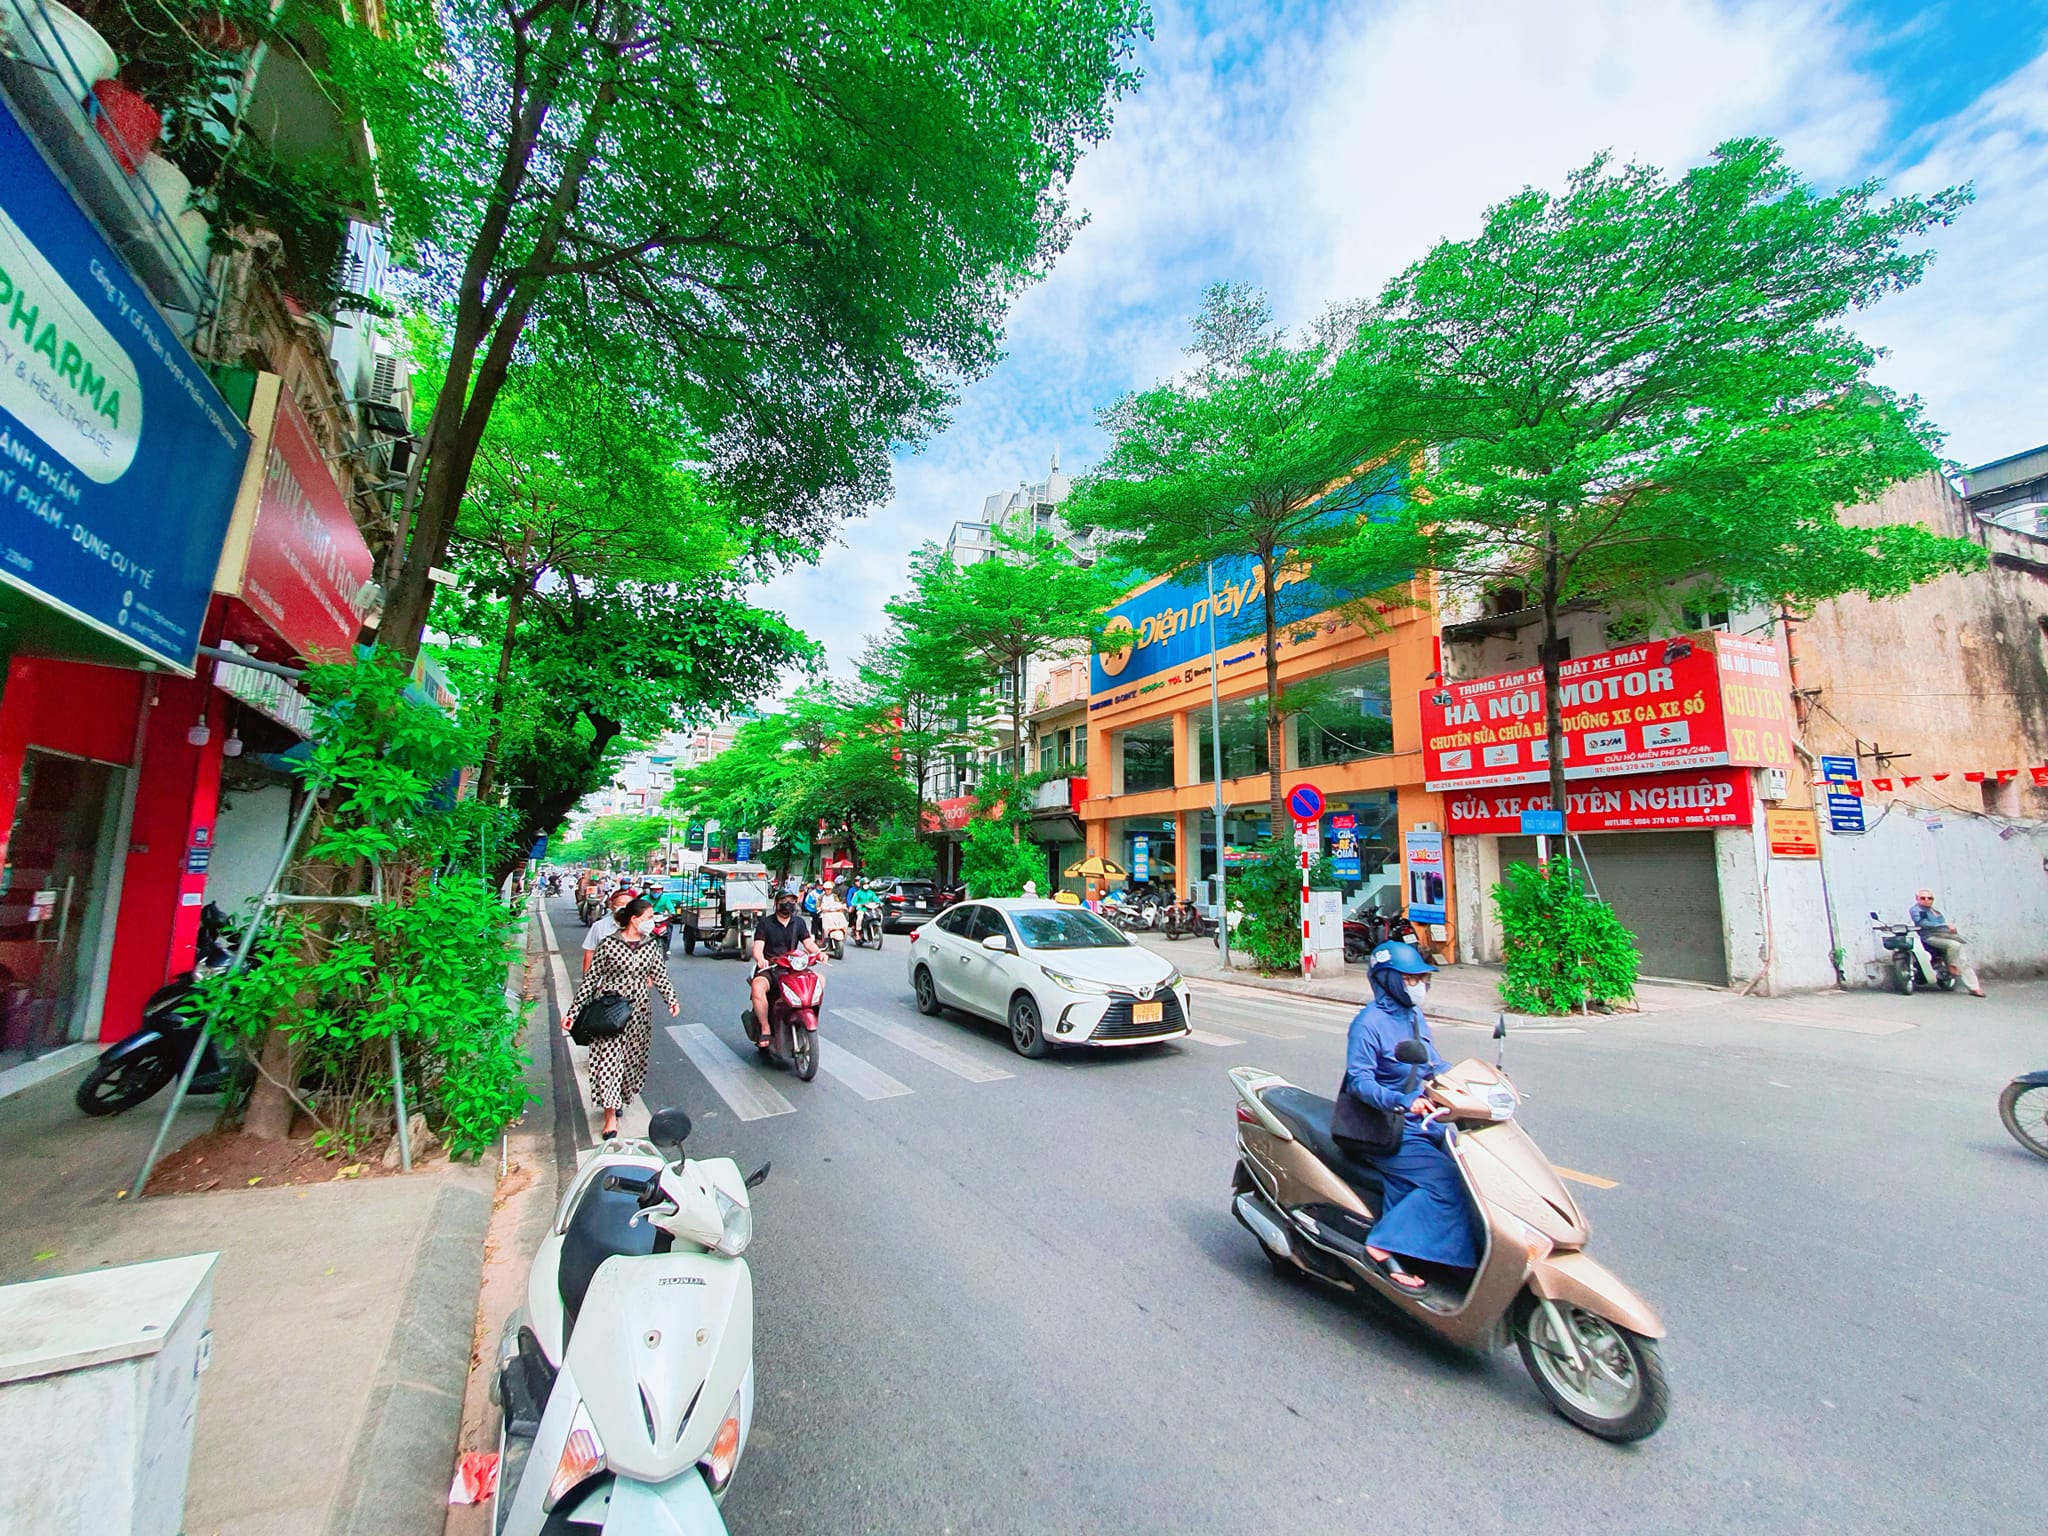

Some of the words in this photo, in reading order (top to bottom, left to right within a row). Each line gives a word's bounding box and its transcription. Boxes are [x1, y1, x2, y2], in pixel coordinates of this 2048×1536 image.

[30, 371, 113, 458] HEALTHCARE
[15, 485, 64, 529] PHẨM
[72, 523, 112, 561] DỤNG
[111, 551, 129, 577] CỤ
[130, 562, 139, 579] Y
[1137, 607, 1189, 648] Điện
[1190, 579, 1251, 628] máy
[1458, 680, 1496, 696] TRUNG
[1498, 673, 1525, 688] TÂM
[1593, 656, 1611, 670] XE
[1615, 649, 1648, 665] MÁY
[1720, 651, 1734, 671] HÀ
[1751, 658, 1780, 678] MOTOR
[1430, 730, 1472, 750] CHUYÊN
[1473, 725, 1497, 744] SỬA
[1498, 722, 1532, 741] CHỮA
[1562, 711, 1610, 733] DƯỠNG
[1612, 709, 1632, 726] XE
[1634, 705, 1657, 722] GA
[1658, 701, 1681, 718] XE
[1683, 690, 1705, 715] SỐ
[1444, 698, 1481, 727] HÀ
[1488, 689, 1540, 720] NỘI
[1599, 737, 1622, 747] SYM
[1652, 737, 1682, 746] SUZUKI
[1731, 728, 1760, 762] XE
[1762, 731, 1790, 764] GA
[1451, 793, 1491, 820] SỬA
[1495, 797, 1522, 818] XE
[1628, 777, 1733, 814] NGHIỆP
